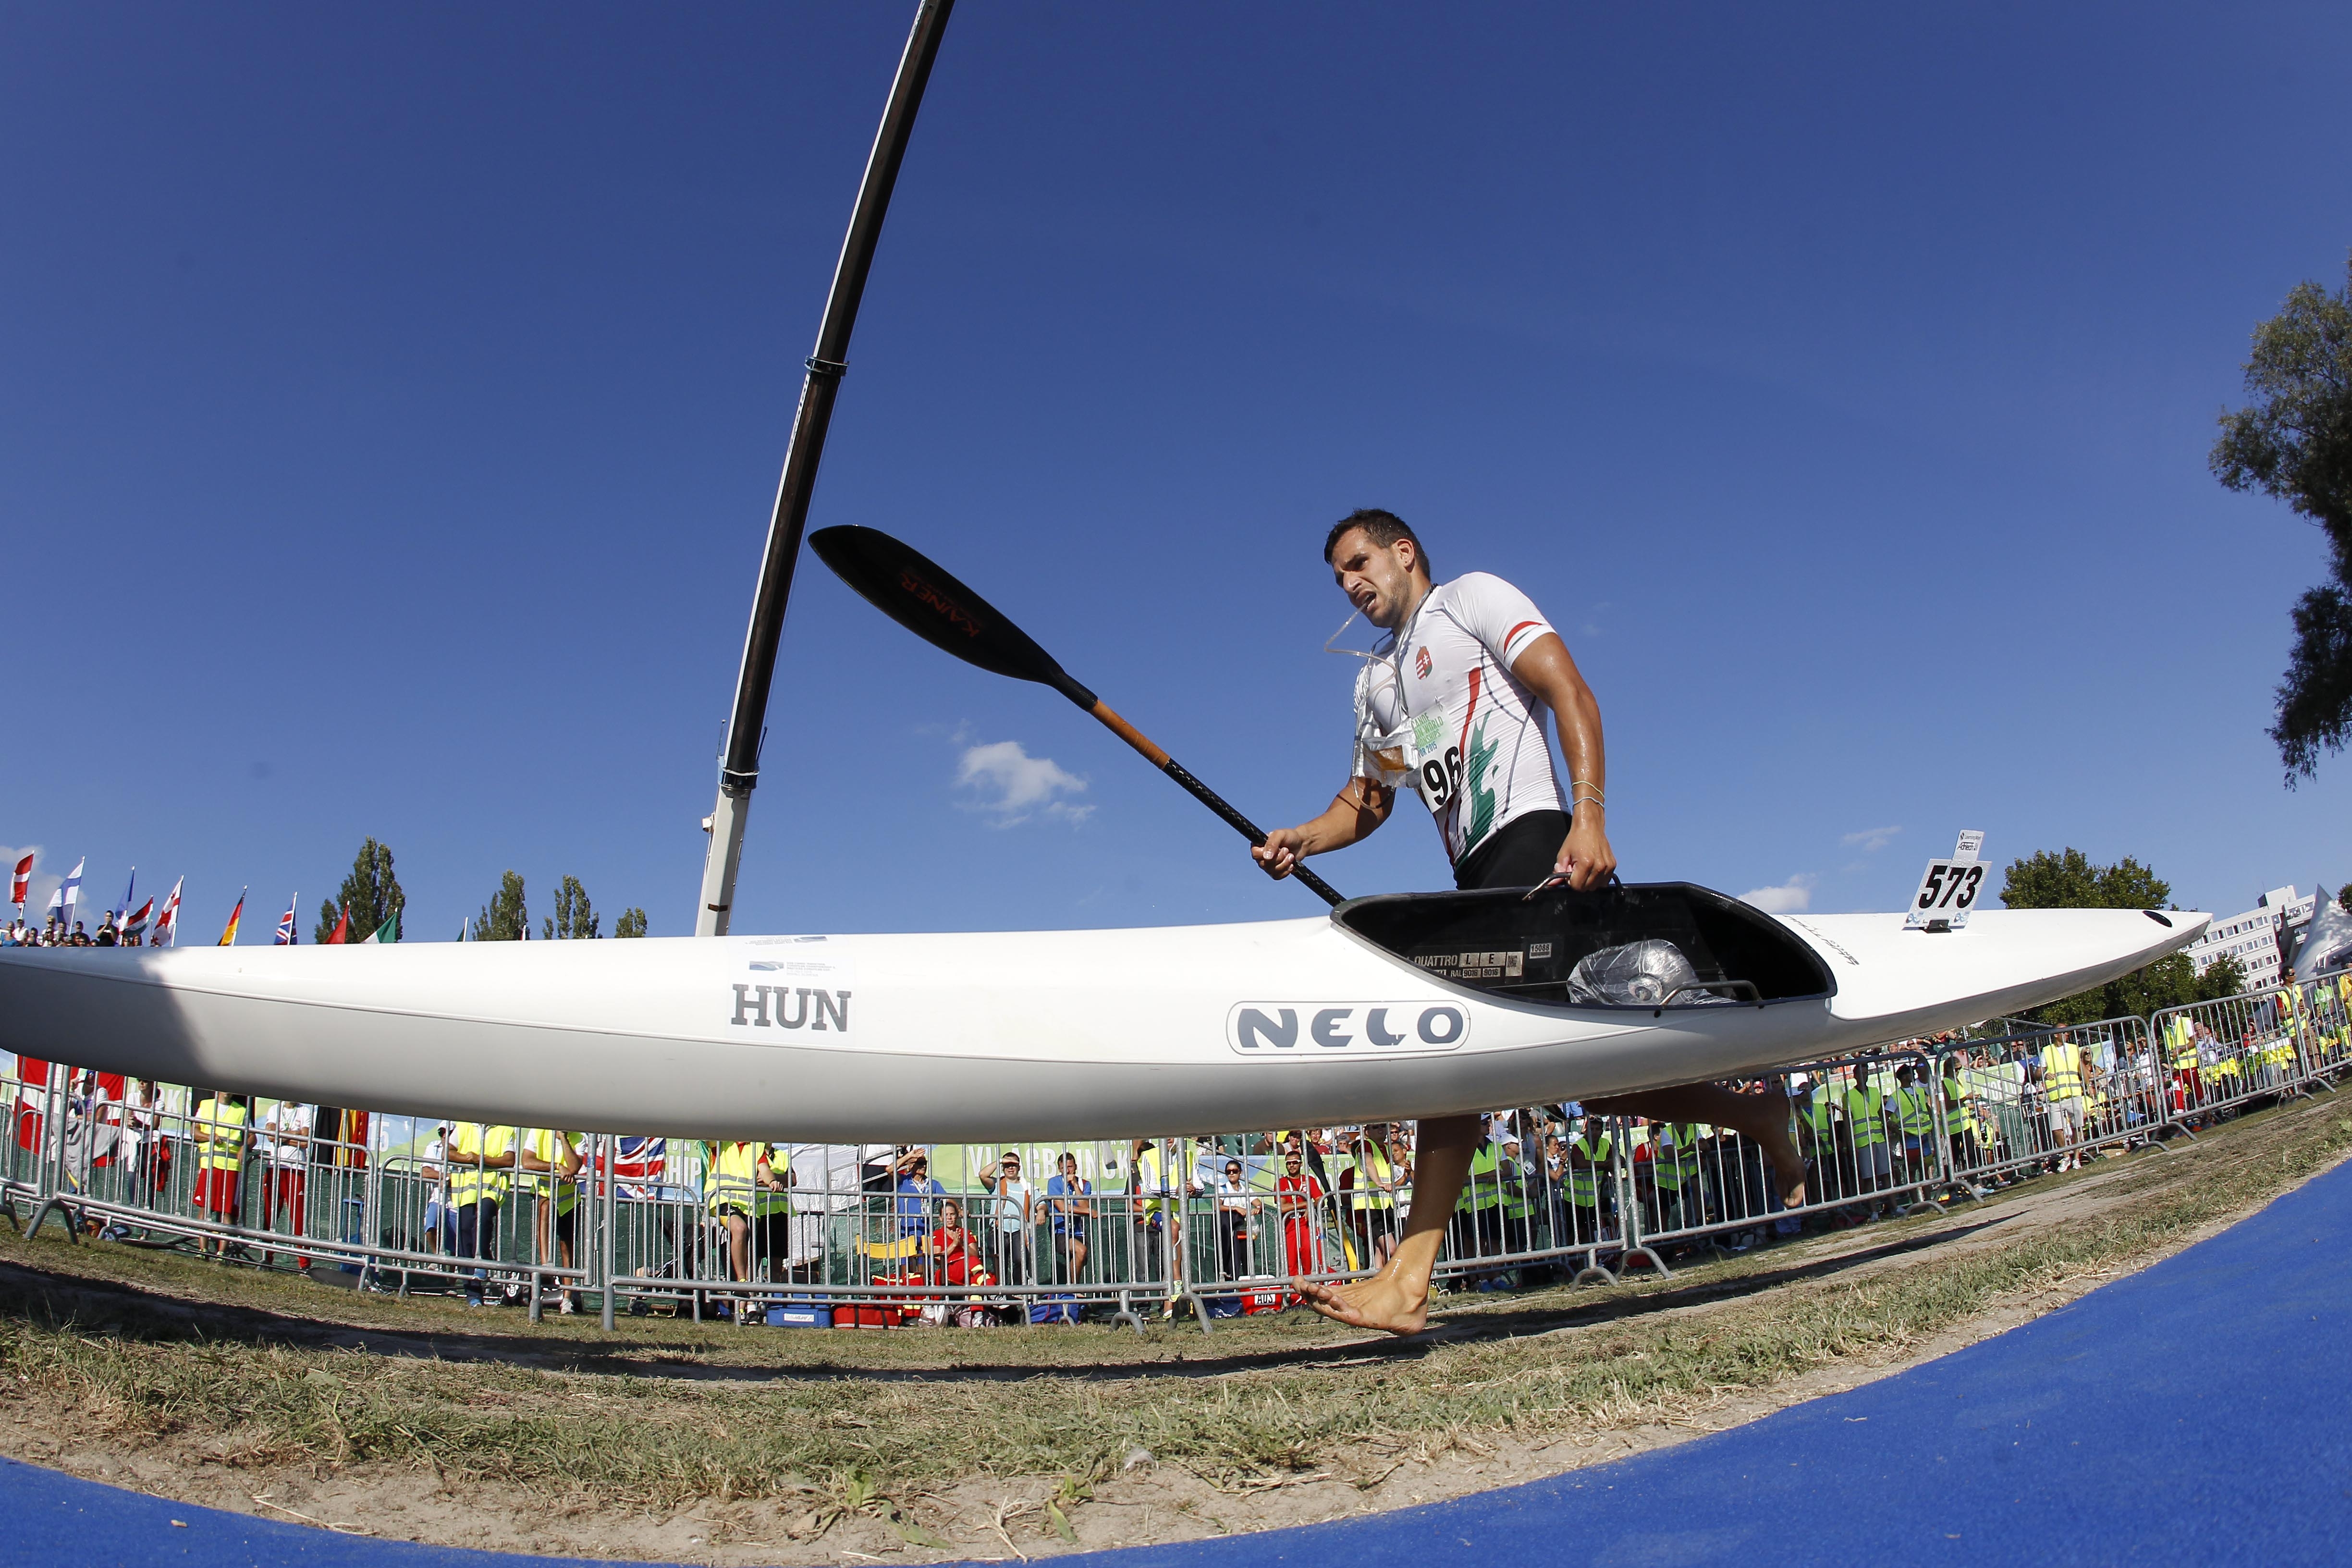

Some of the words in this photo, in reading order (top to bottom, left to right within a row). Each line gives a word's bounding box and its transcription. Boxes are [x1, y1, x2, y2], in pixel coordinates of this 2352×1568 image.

[1412, 712, 1430, 728] CANOE
[1423, 716, 1444, 735] WORLD
[1426, 741, 1437, 753] 2015
[1423, 746, 1462, 806] 96
[1918, 865, 1983, 909] 573
[1414, 955, 1458, 967] QUATTRO
[1466, 955, 1470, 965] L
[1489, 954, 1494, 964] E
[731, 983, 852, 1032] HUN
[1237, 1006, 1464, 1048] NELO
[1257, 1294, 1273, 1304] AUS
